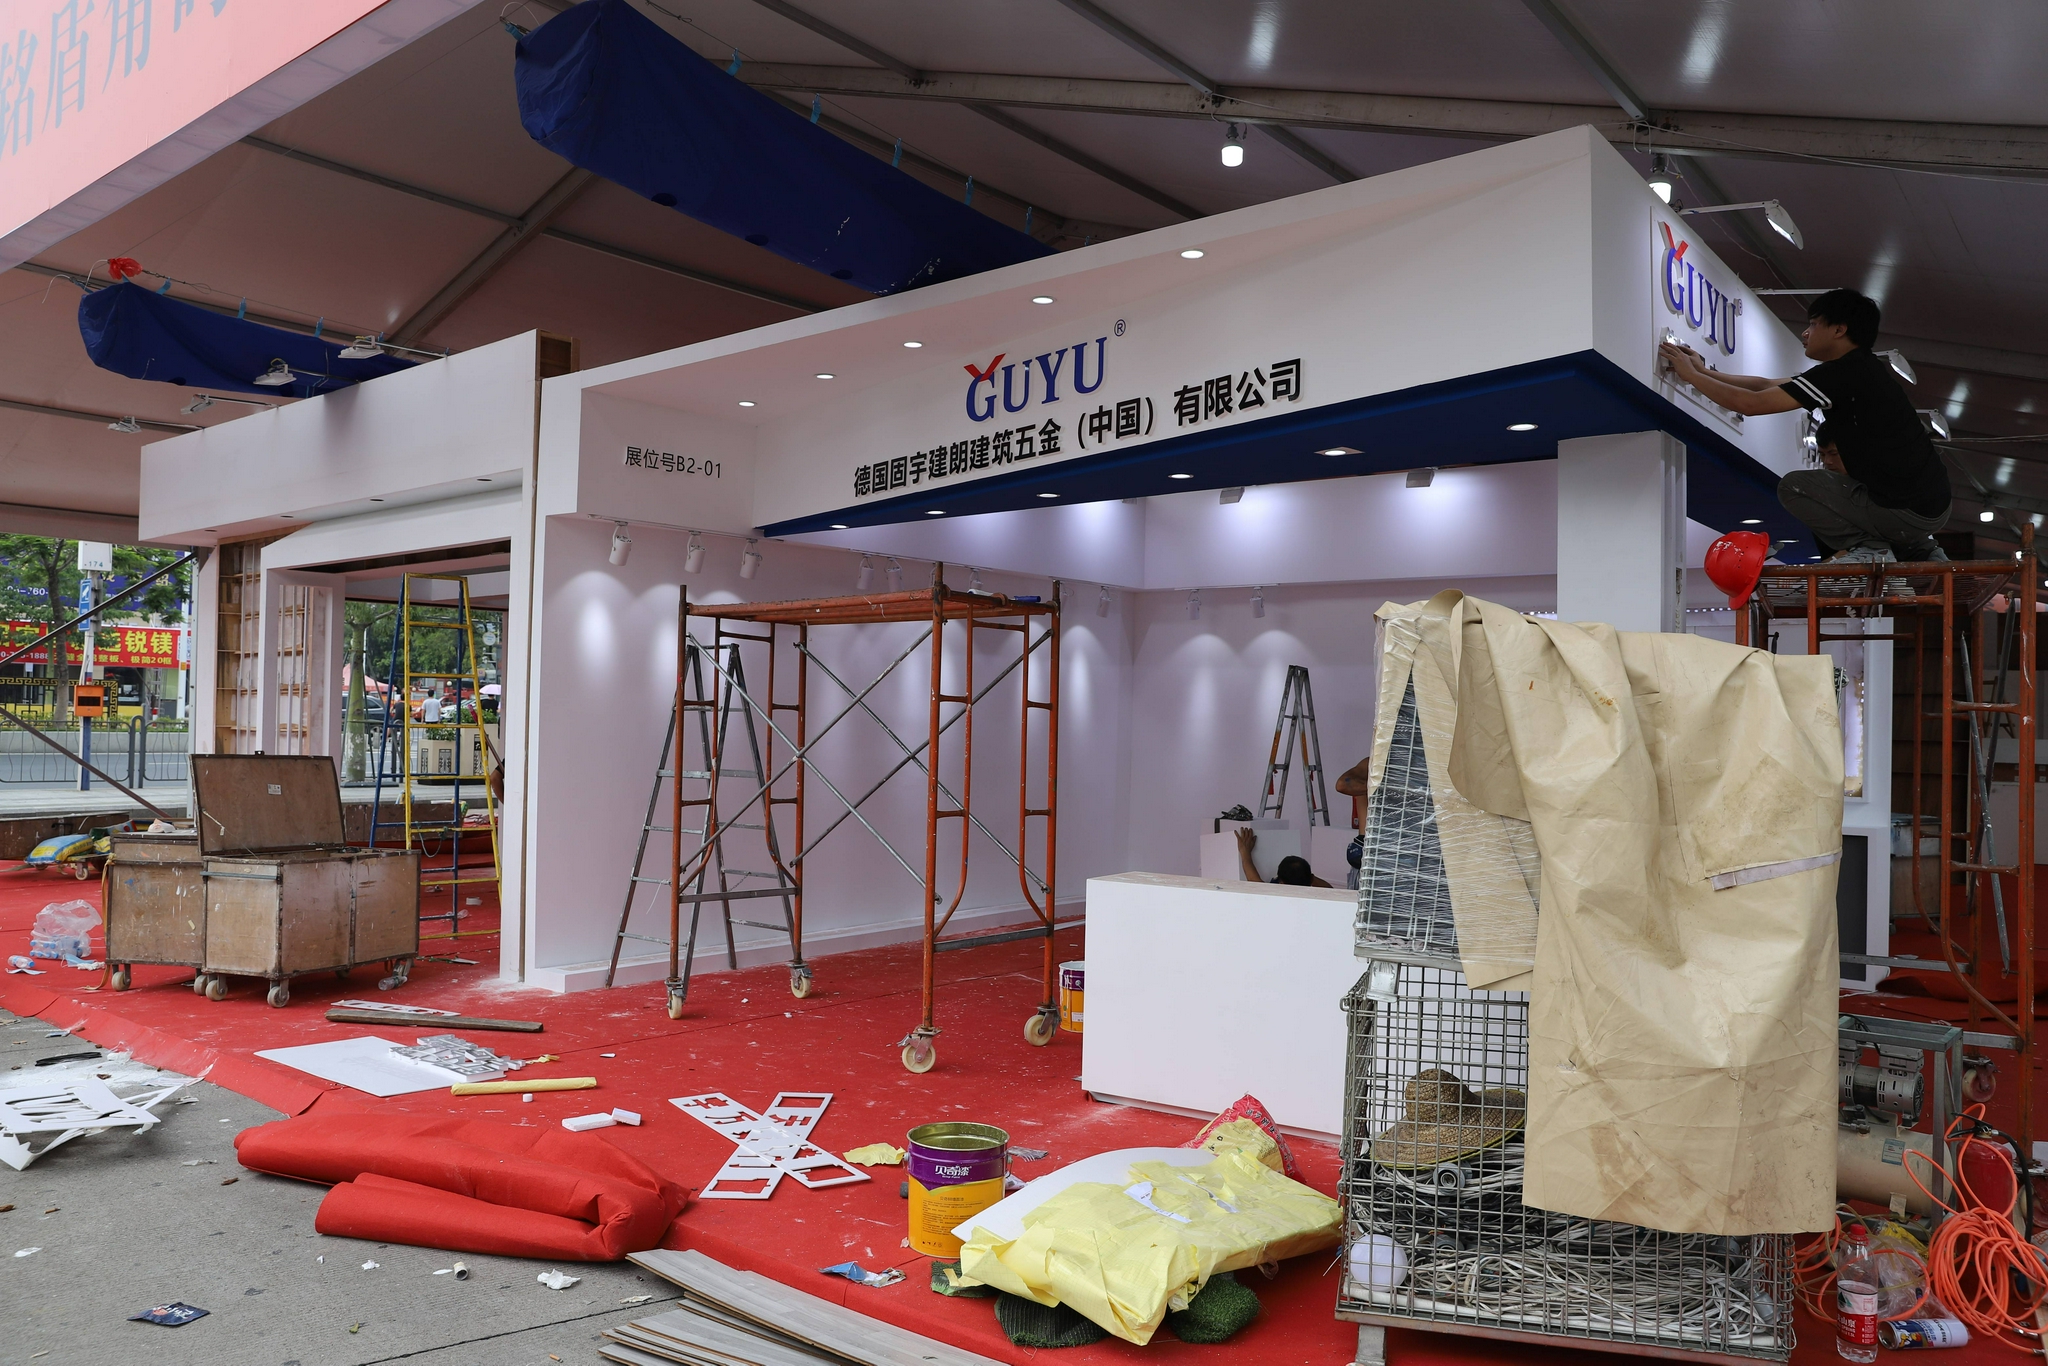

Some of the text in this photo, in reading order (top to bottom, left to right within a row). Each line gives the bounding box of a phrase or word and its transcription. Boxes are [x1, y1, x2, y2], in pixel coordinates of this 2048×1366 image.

[1660, 222, 1736, 357] GUYU
[964, 336, 1108, 423] GUYU
[625, 446, 721, 479] 展位号B2-01
[88, 560, 103, 568] 174
